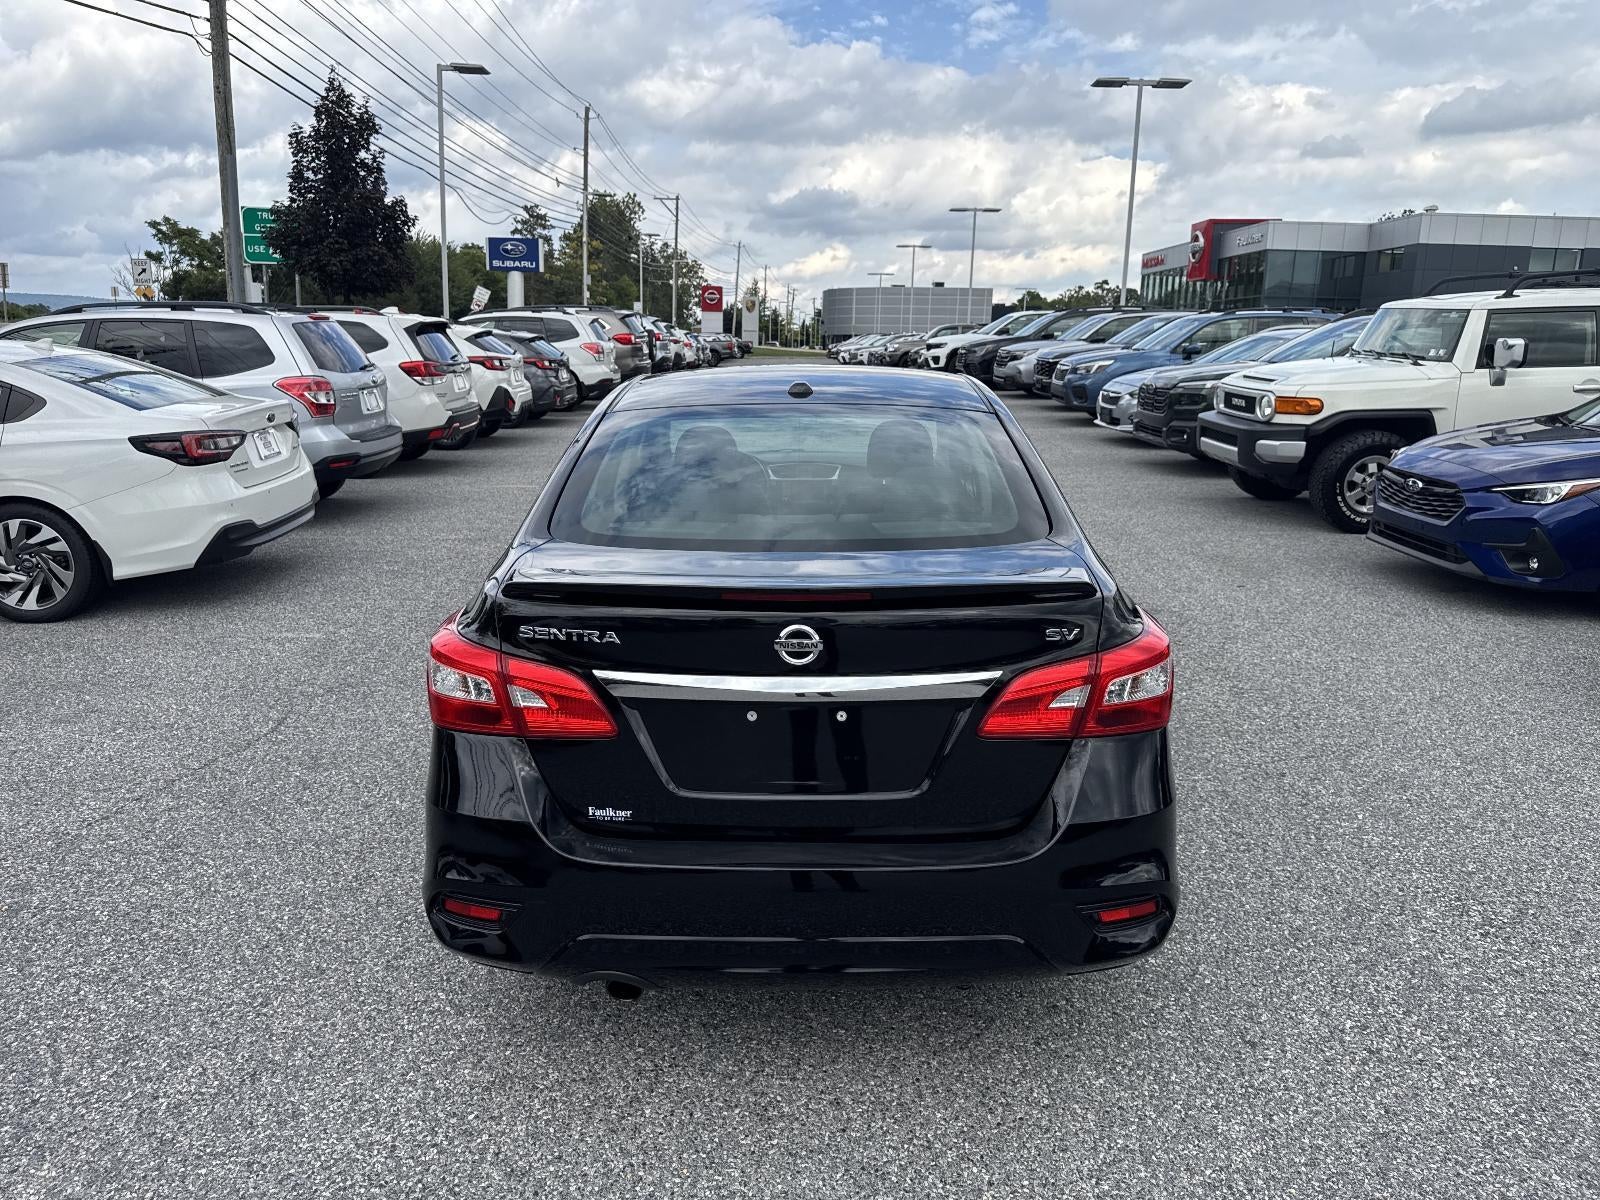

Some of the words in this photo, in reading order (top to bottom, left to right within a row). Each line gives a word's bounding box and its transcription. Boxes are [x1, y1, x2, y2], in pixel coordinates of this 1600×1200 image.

[257, 211, 276, 220] TRU
[247, 245, 266, 253] USE
[492, 260, 536, 269] SUBARU
[518, 625, 621, 644] SENTRA
[1045, 628, 1081, 641] SV
[779, 642, 819, 650] NISSAN
[587, 806, 633, 818] Faulkner
